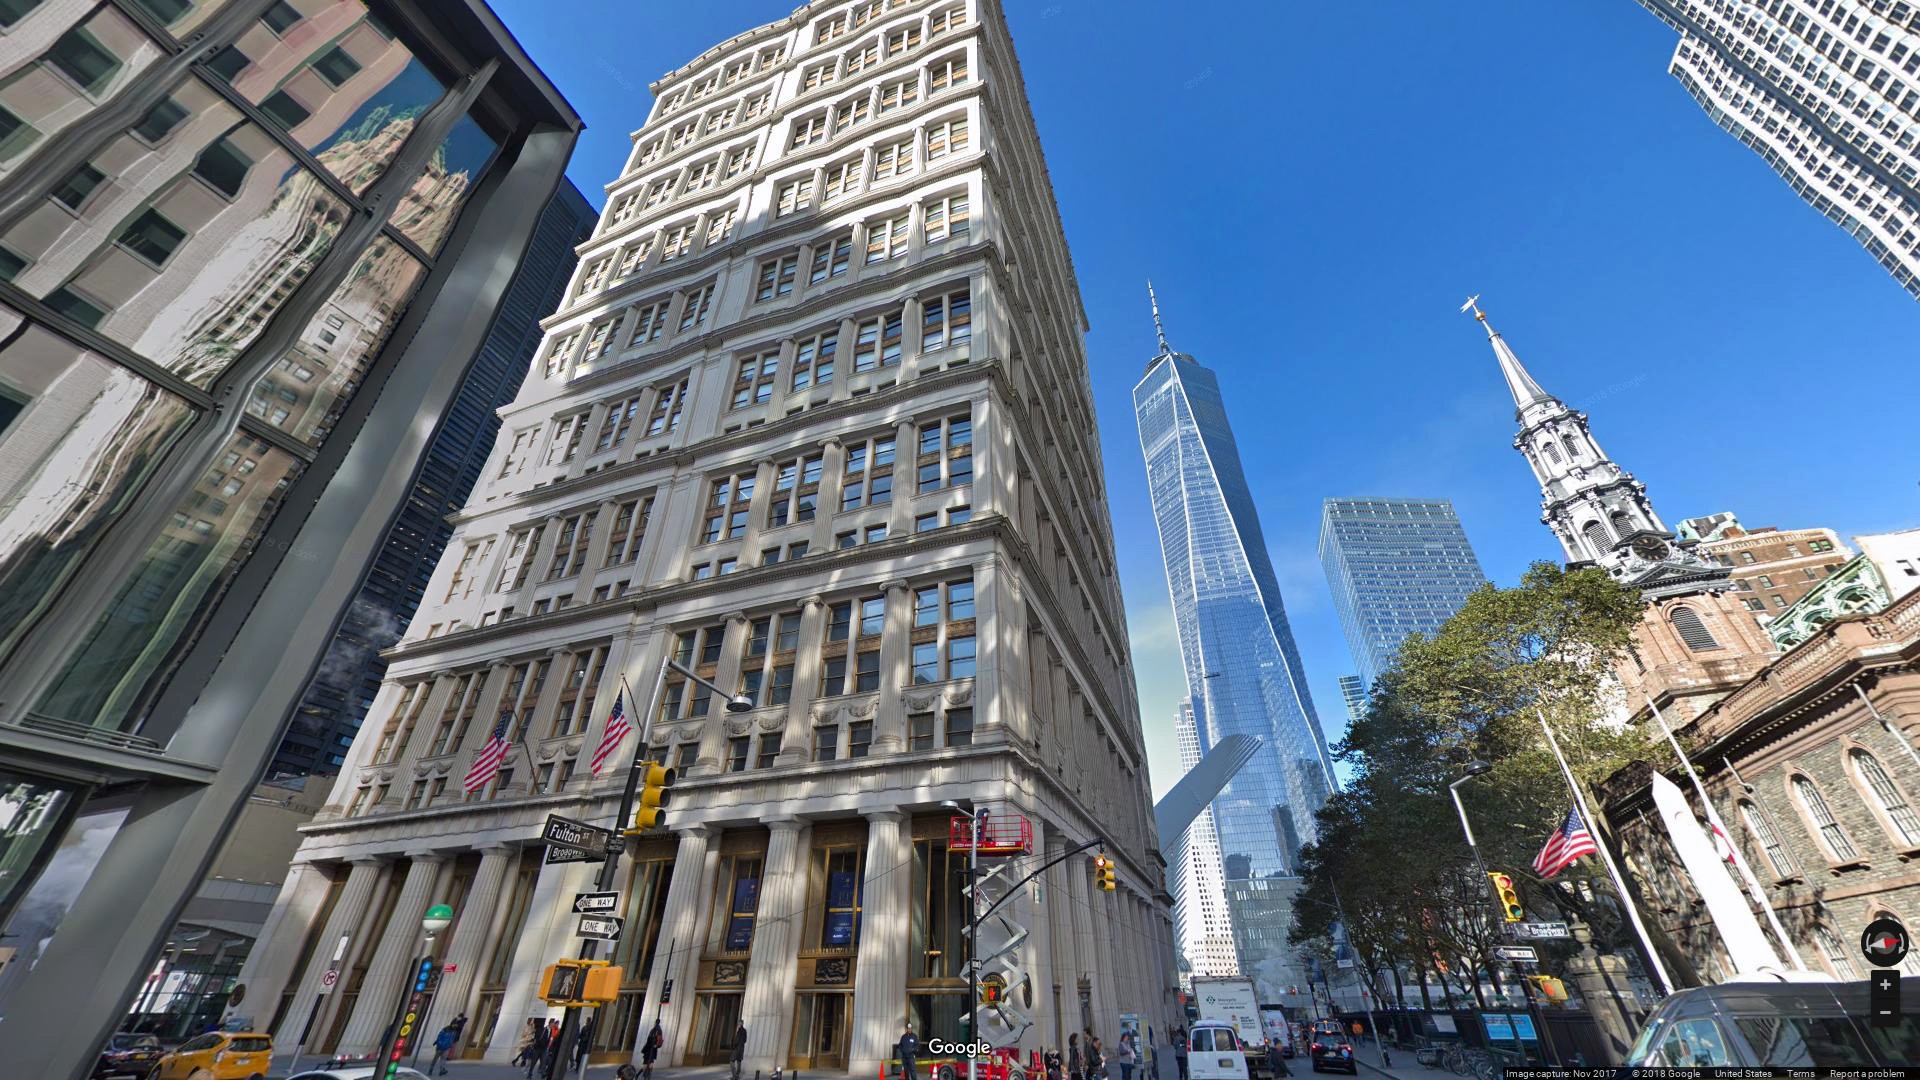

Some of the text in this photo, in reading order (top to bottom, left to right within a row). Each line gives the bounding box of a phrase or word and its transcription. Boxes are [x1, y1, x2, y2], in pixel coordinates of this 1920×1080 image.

[550, 824, 581, 843] Fulton
[579, 898, 612, 907] ONE WAY
[584, 921, 616, 933] ONE WAY
[1531, 926, 1565, 937] Broadway
